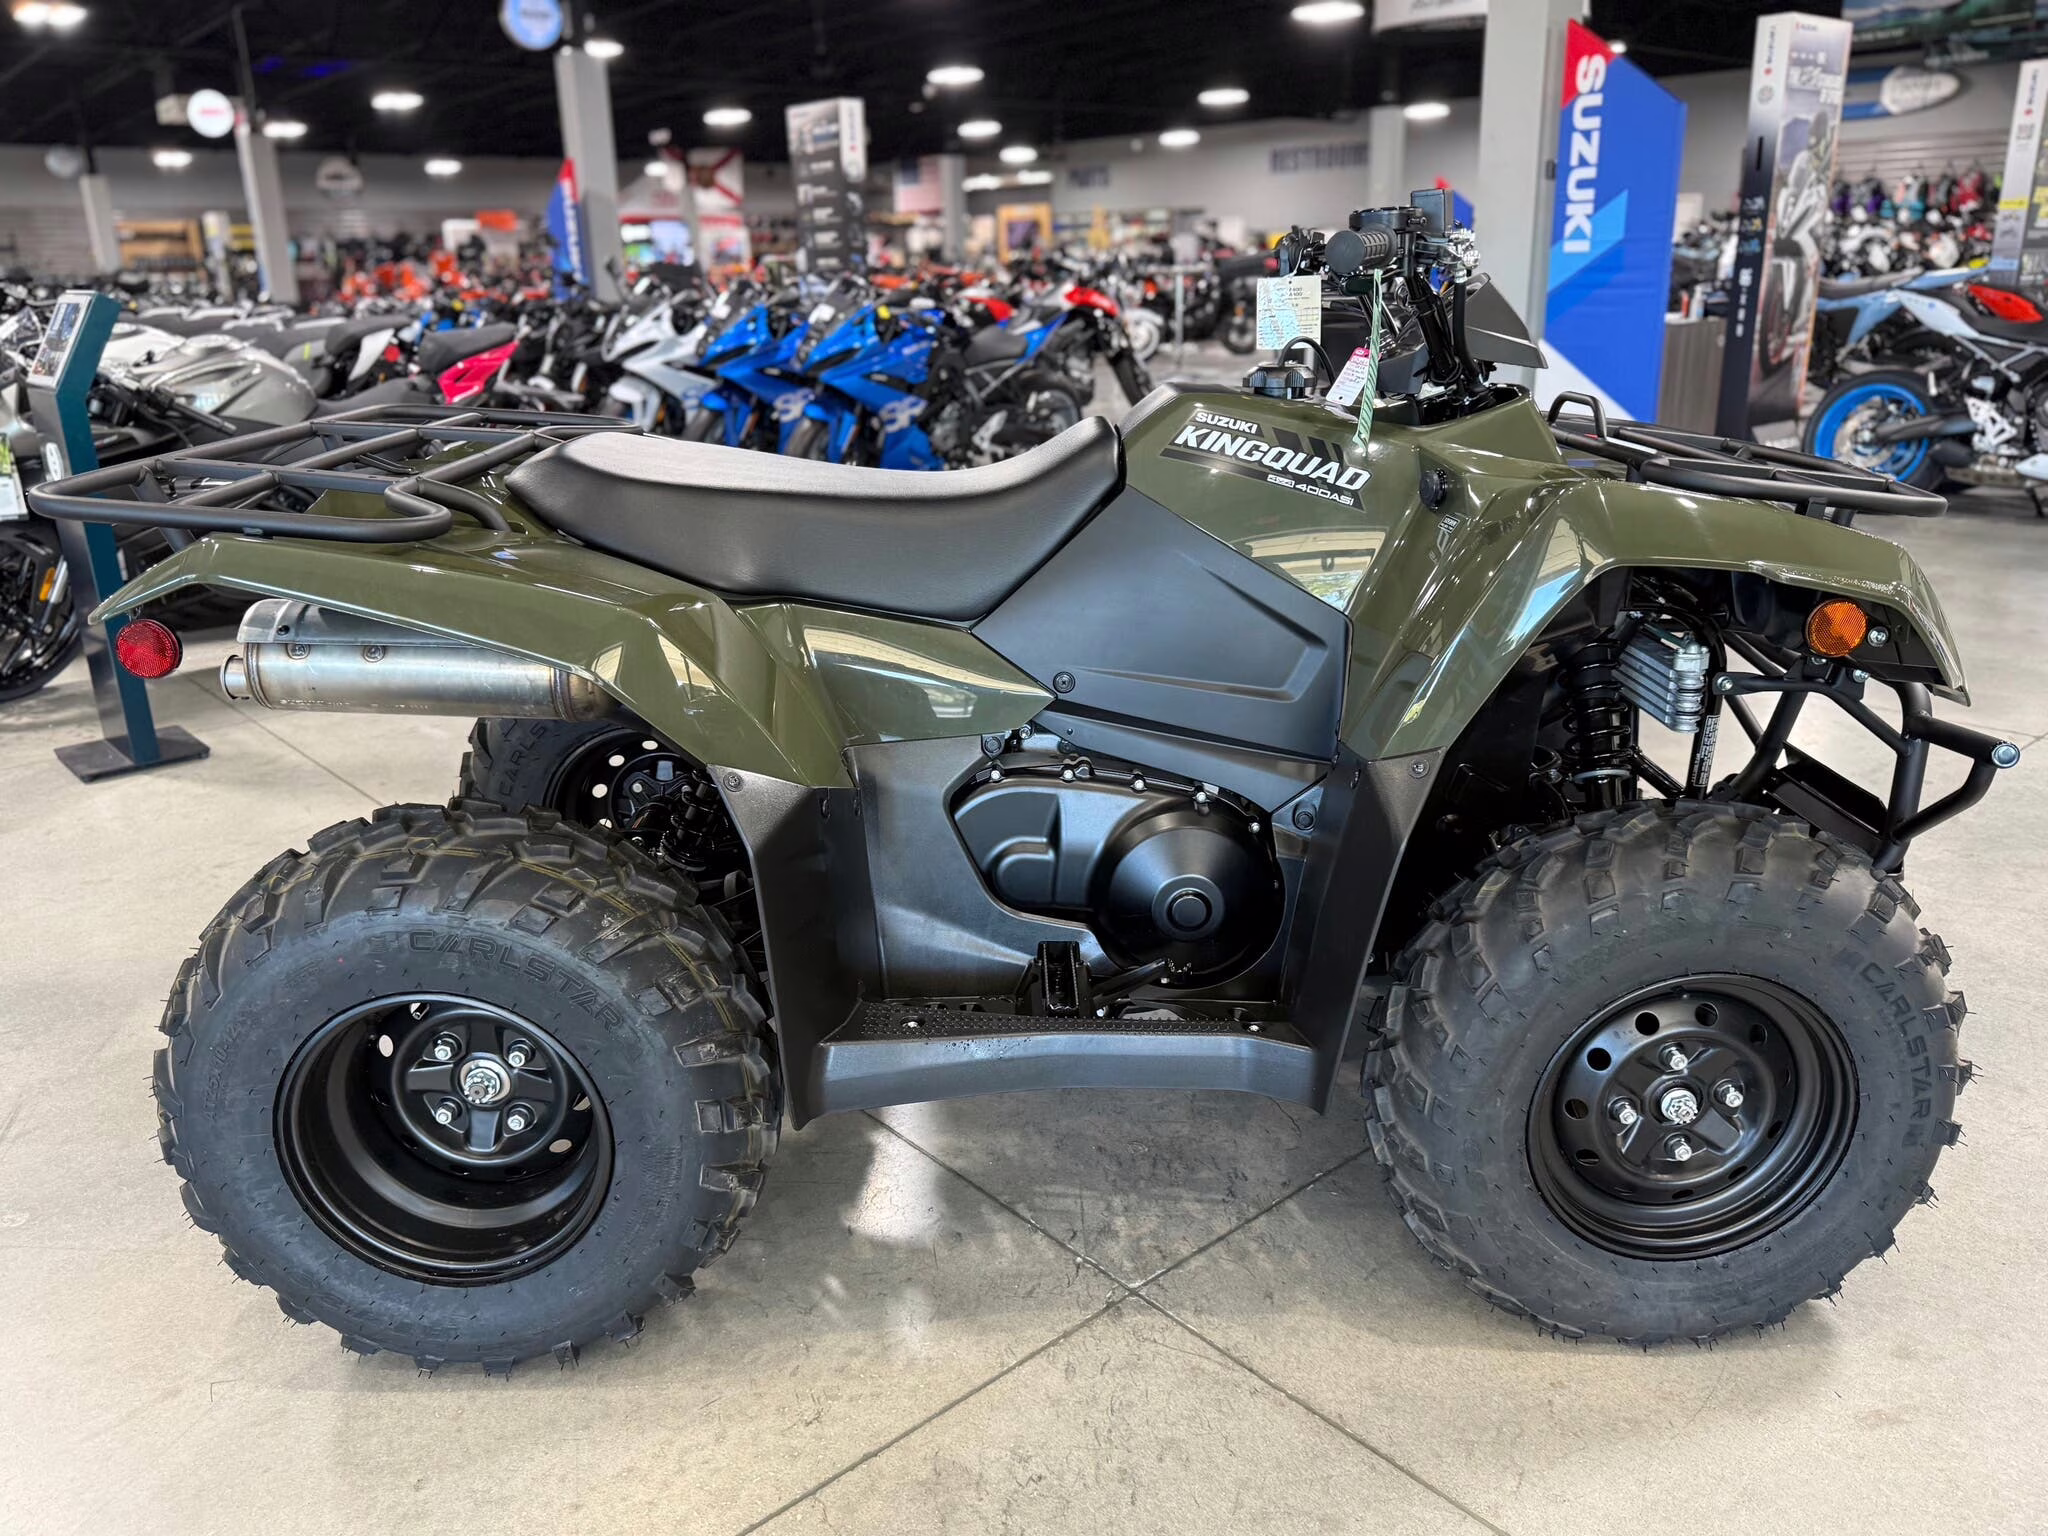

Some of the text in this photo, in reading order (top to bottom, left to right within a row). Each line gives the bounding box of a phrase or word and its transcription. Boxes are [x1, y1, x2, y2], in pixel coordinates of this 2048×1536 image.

[1563, 53, 1607, 254] SUZUKI
[1174, 425, 1373, 490] KINGQUAD
[1195, 411, 1258, 434] SUZUKI
[1295, 483, 1354, 506] 400ASI
[500, 721, 546, 796] CARLS
[409, 929, 624, 1032] CARLSTAR
[1860, 962, 1933, 1120] CARLSTAR
